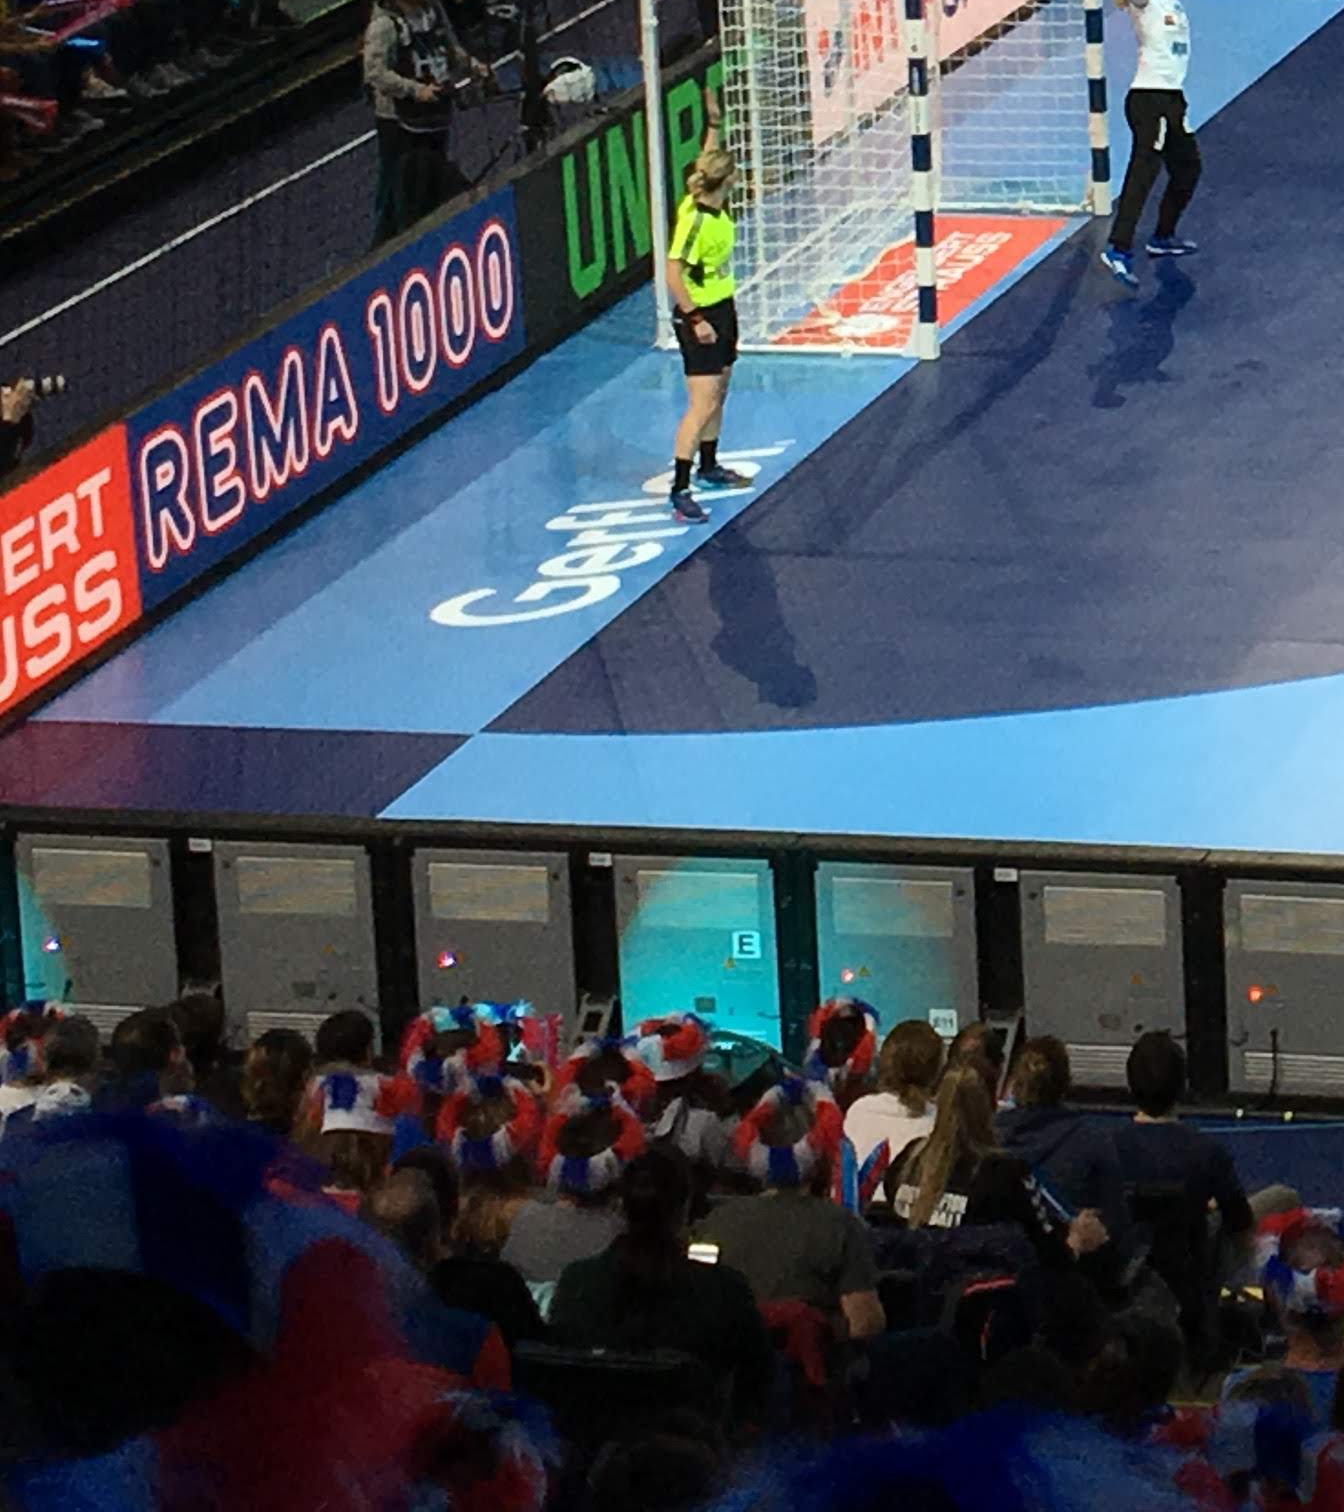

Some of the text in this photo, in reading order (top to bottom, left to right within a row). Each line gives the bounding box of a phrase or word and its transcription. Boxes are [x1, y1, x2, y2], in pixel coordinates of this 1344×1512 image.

[138, 219, 516, 571] REMA 1000
[737, 934, 755, 954] E
